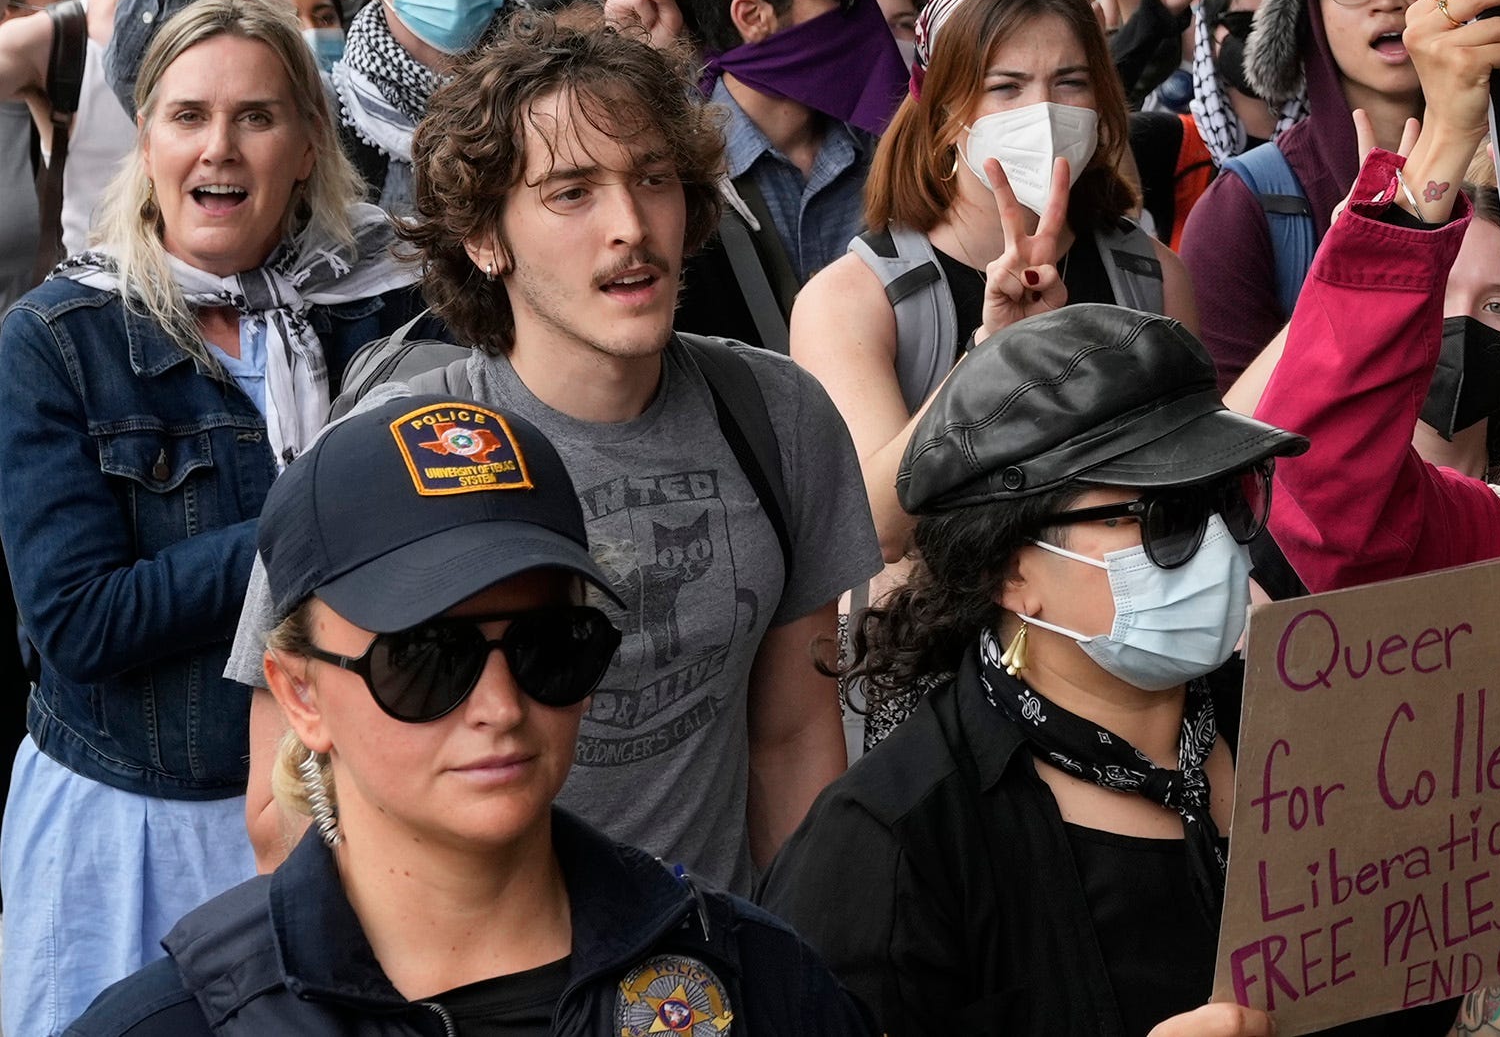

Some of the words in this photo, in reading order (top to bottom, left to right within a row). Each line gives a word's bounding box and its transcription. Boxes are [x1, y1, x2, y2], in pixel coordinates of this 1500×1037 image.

[410, 410, 487, 431] POLICE
[424, 465, 478, 479] UNIVERSITY
[458, 473, 497, 487] SYSTEM
[1276, 608, 1472, 693] Queer
[1250, 738, 1345, 835] for
[1229, 916, 1357, 1011] FREE
[1402, 951, 1483, 1009] END
